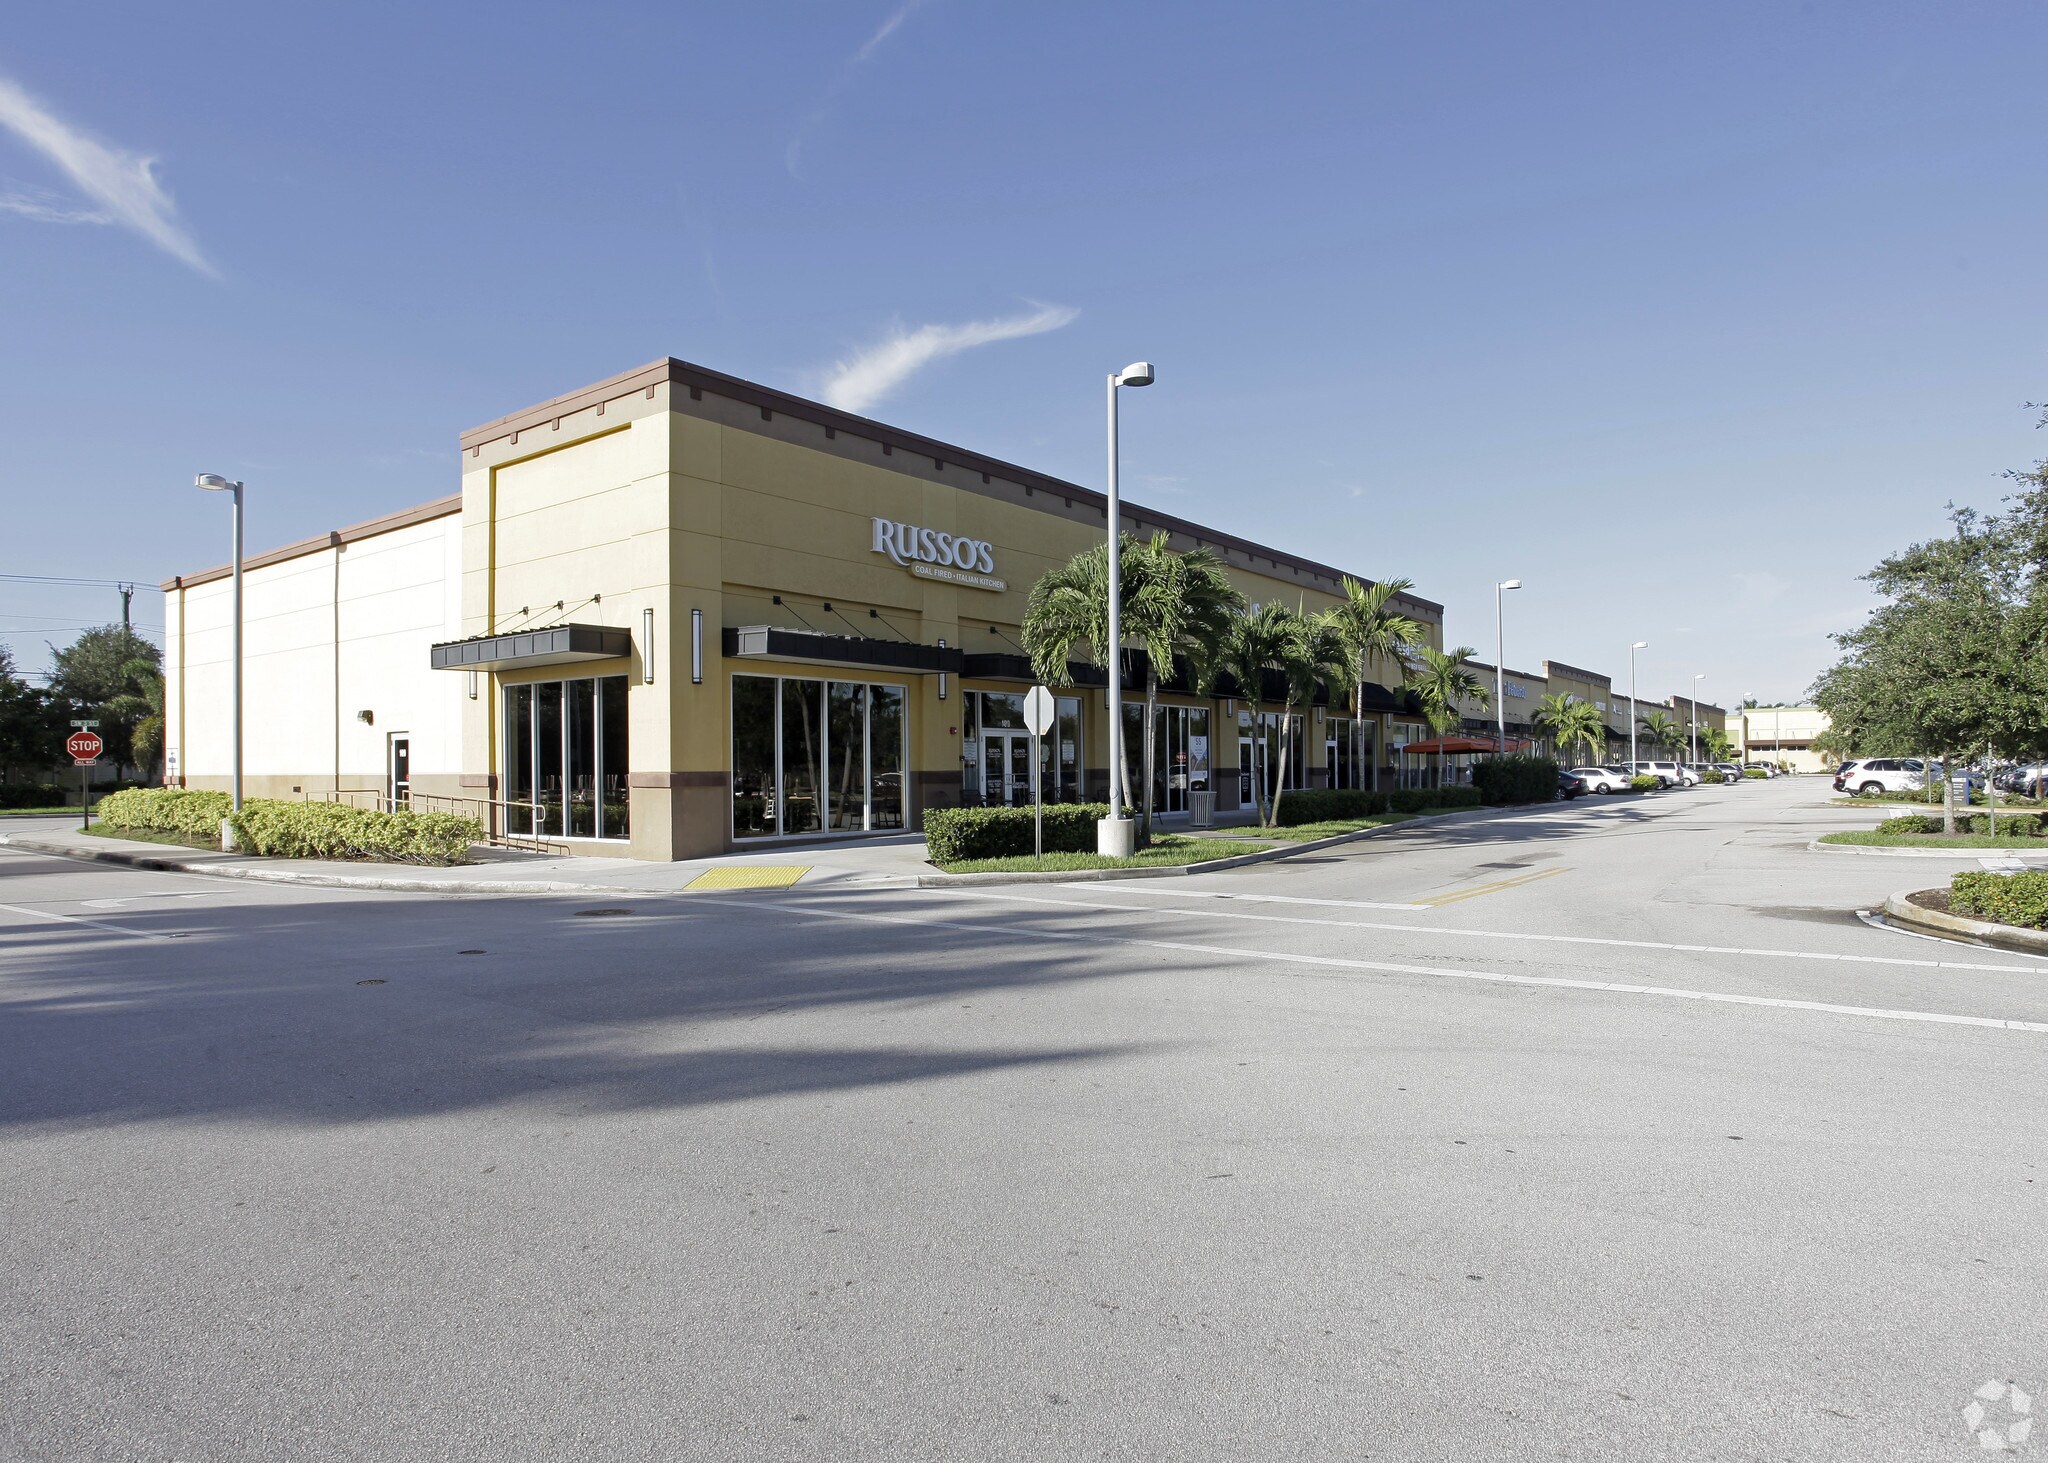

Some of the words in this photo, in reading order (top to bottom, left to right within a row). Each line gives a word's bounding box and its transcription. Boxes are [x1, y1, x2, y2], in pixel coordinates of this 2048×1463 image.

[870, 516, 994, 574] RUSSO'S
[915, 564, 933, 576] COAL
[934, 568, 953, 579] FIRED
[956, 573, 979, 584] ITALIAN
[979, 577, 1004, 589] KITCHEN
[71, 740, 100, 751] STOP
